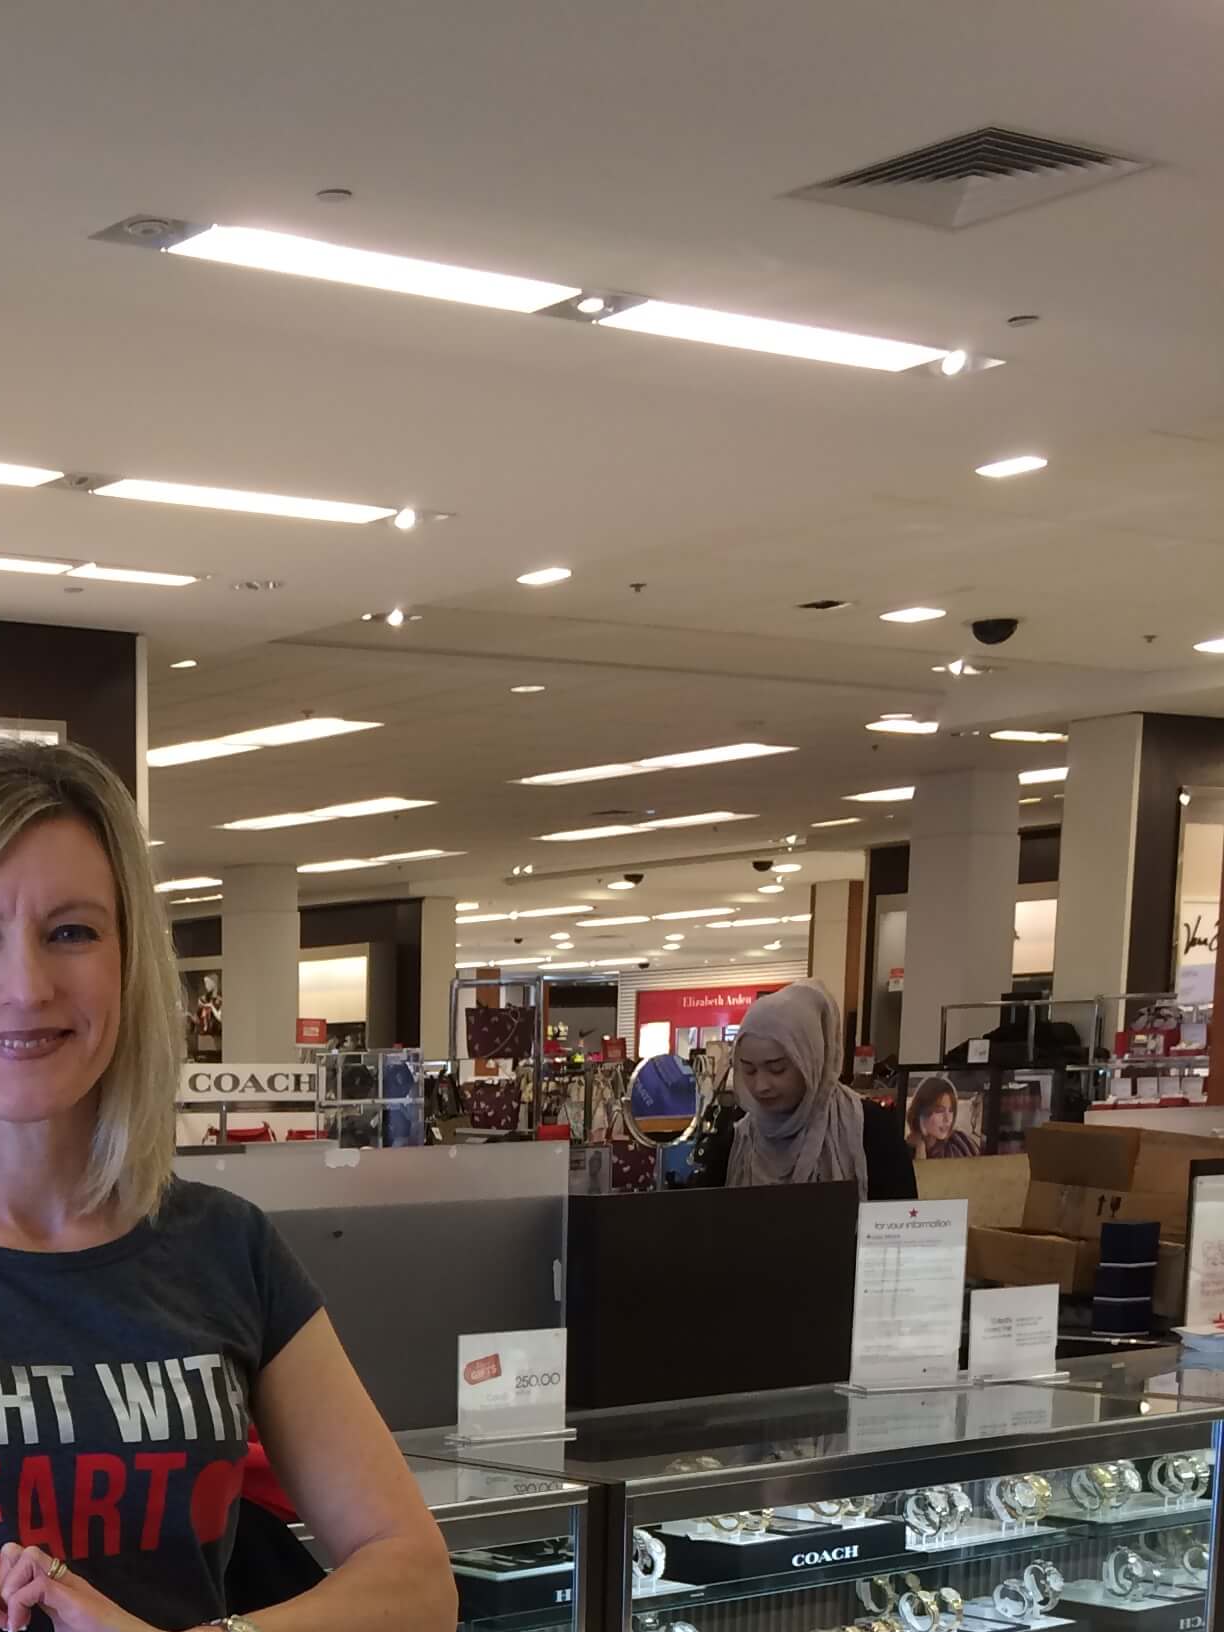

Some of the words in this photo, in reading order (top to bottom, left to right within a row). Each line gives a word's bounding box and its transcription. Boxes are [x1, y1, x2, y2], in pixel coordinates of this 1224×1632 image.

[682, 994, 724, 1008] Elizabeth
[726, 993, 753, 1007] Arden
[188, 1072, 317, 1094] COACH
[515, 1372, 561, 1389] 250.00
[95, 1353, 251, 1443] WITH
[791, 1544, 860, 1568] COACH
